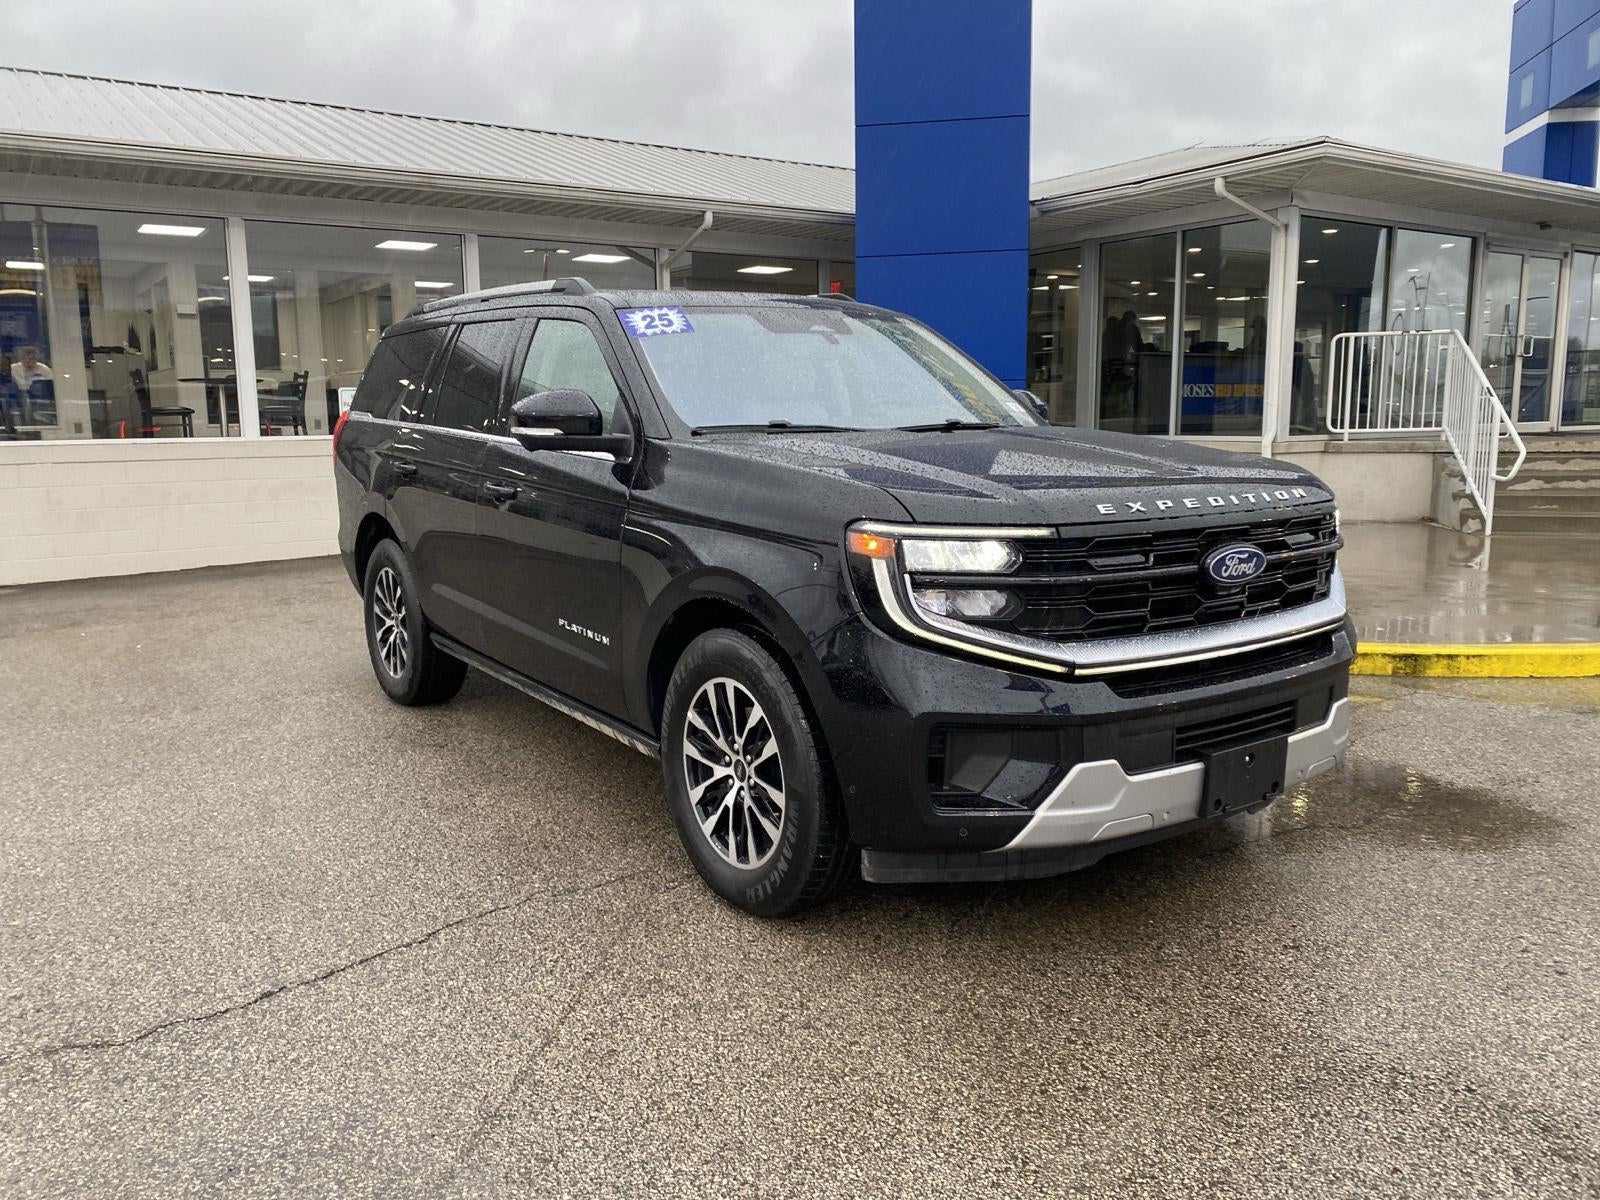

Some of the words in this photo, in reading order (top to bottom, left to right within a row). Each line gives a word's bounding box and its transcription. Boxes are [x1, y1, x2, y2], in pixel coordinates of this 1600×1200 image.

[641, 312, 675, 330] 25
[1097, 488, 1307, 515] EXPEDITION
[1222, 553, 1255, 577] Ford
[558, 618, 610, 646] PLATINUM
